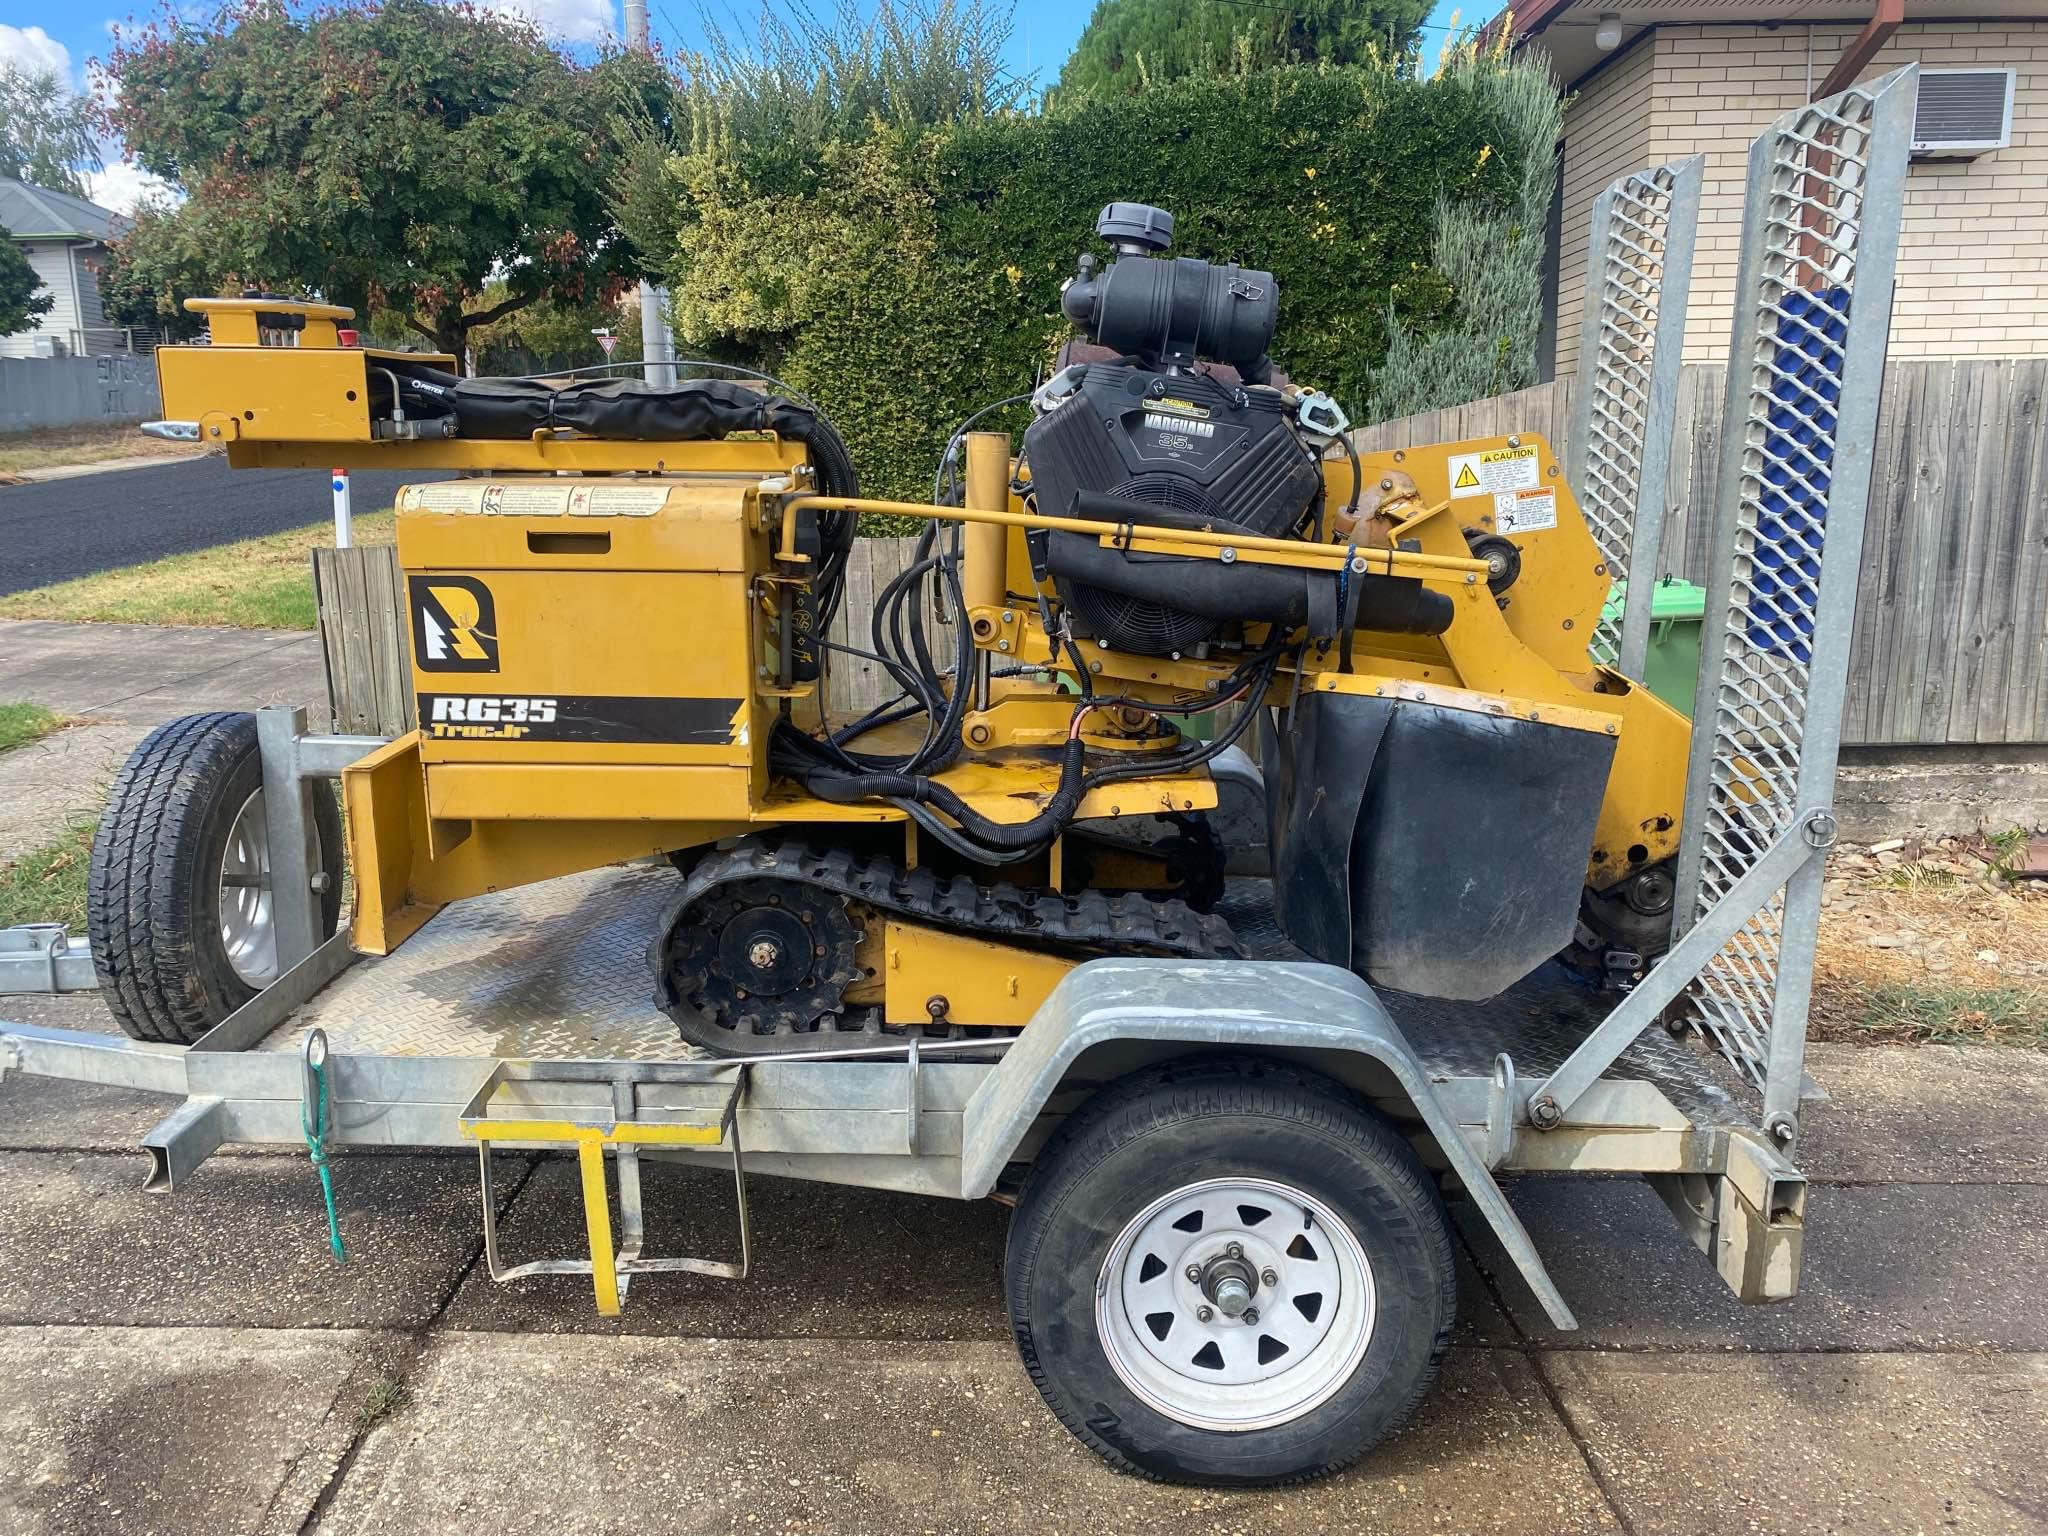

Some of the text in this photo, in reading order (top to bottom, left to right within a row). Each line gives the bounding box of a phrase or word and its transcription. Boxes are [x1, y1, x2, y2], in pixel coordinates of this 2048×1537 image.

[1144, 413, 1214, 438] VANGUARD
[1493, 448, 1534, 461] CAUTION
[432, 697, 558, 723] RG35
